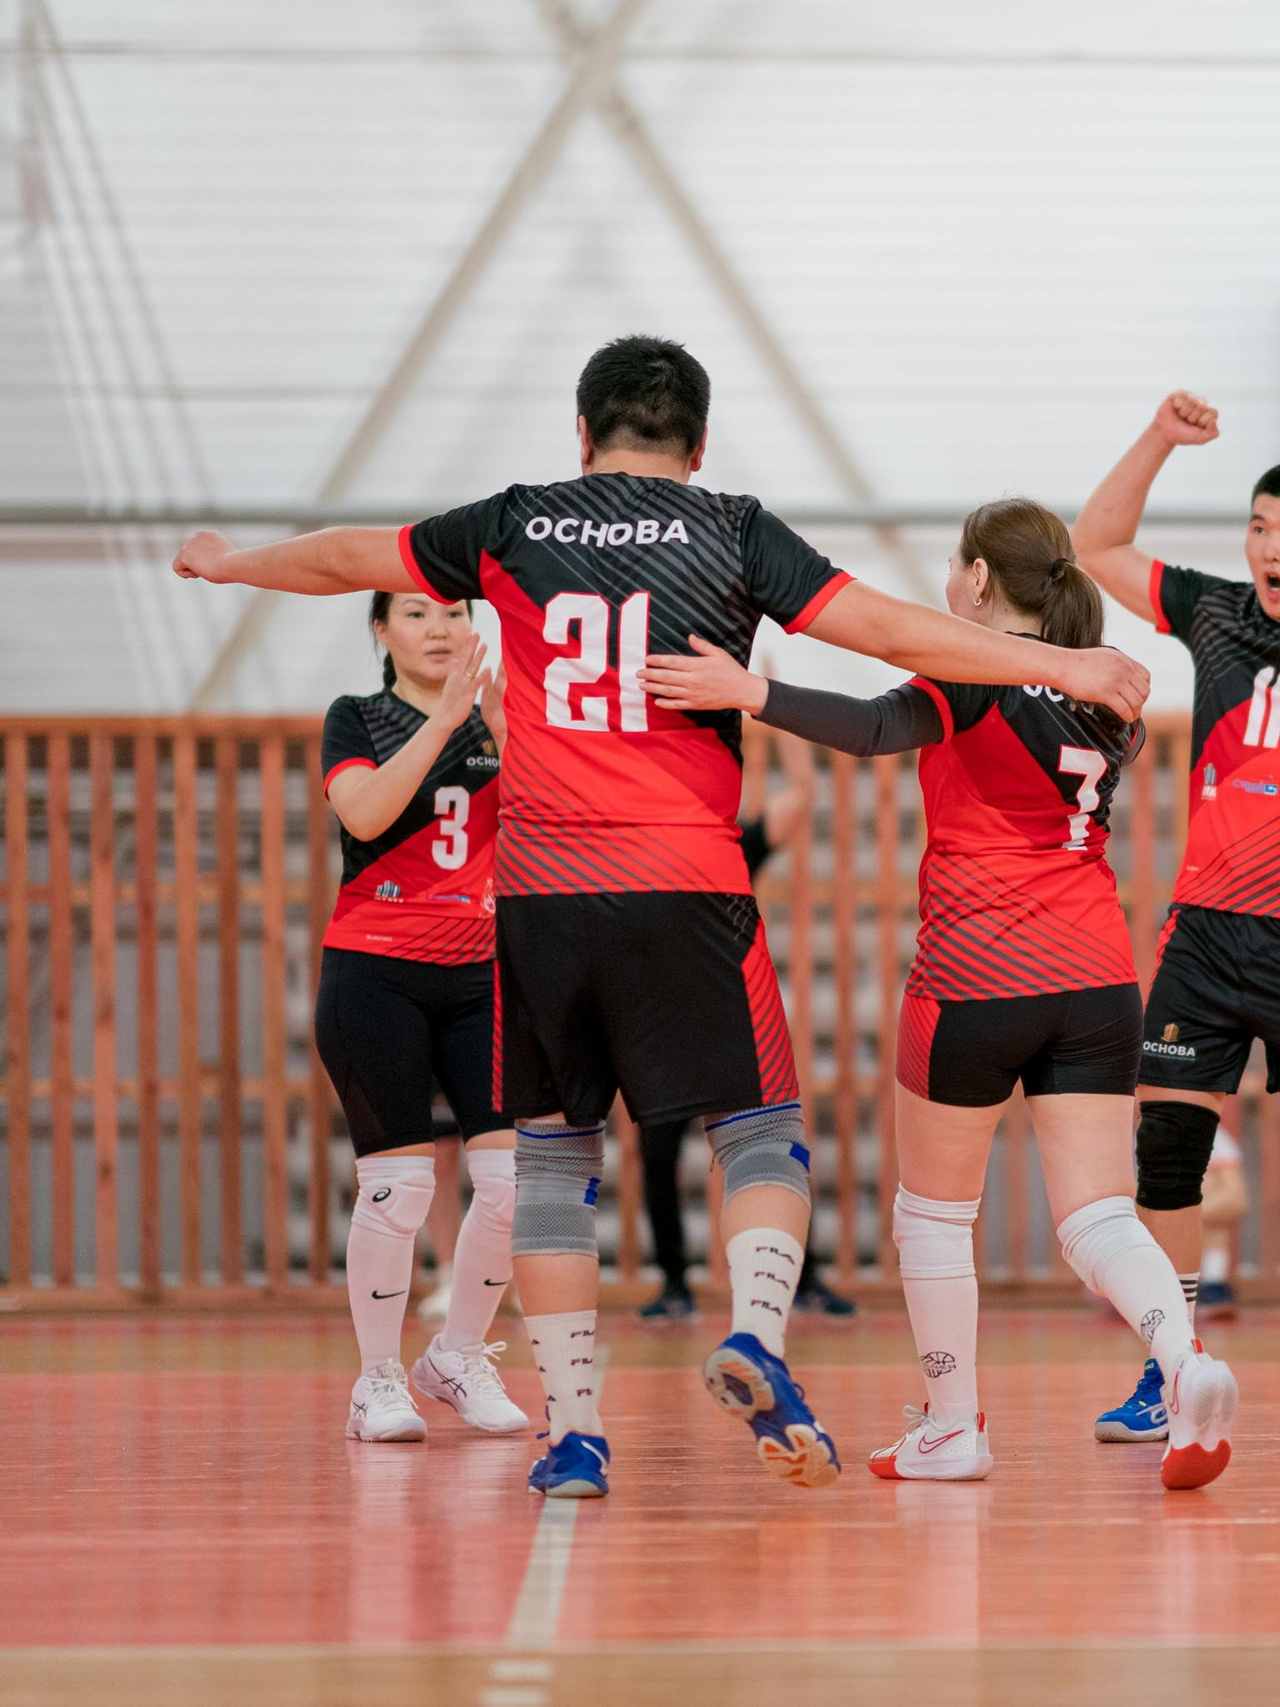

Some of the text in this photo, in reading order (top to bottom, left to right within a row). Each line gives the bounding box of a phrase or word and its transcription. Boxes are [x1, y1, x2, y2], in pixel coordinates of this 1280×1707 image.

[525, 516, 690, 548] ОСНОВА
[543, 591, 650, 733] 21
[432, 786, 470, 870] 3
[1058, 744, 1109, 851] 7
[1142, 1040, 1197, 1057] ОСНОВА
